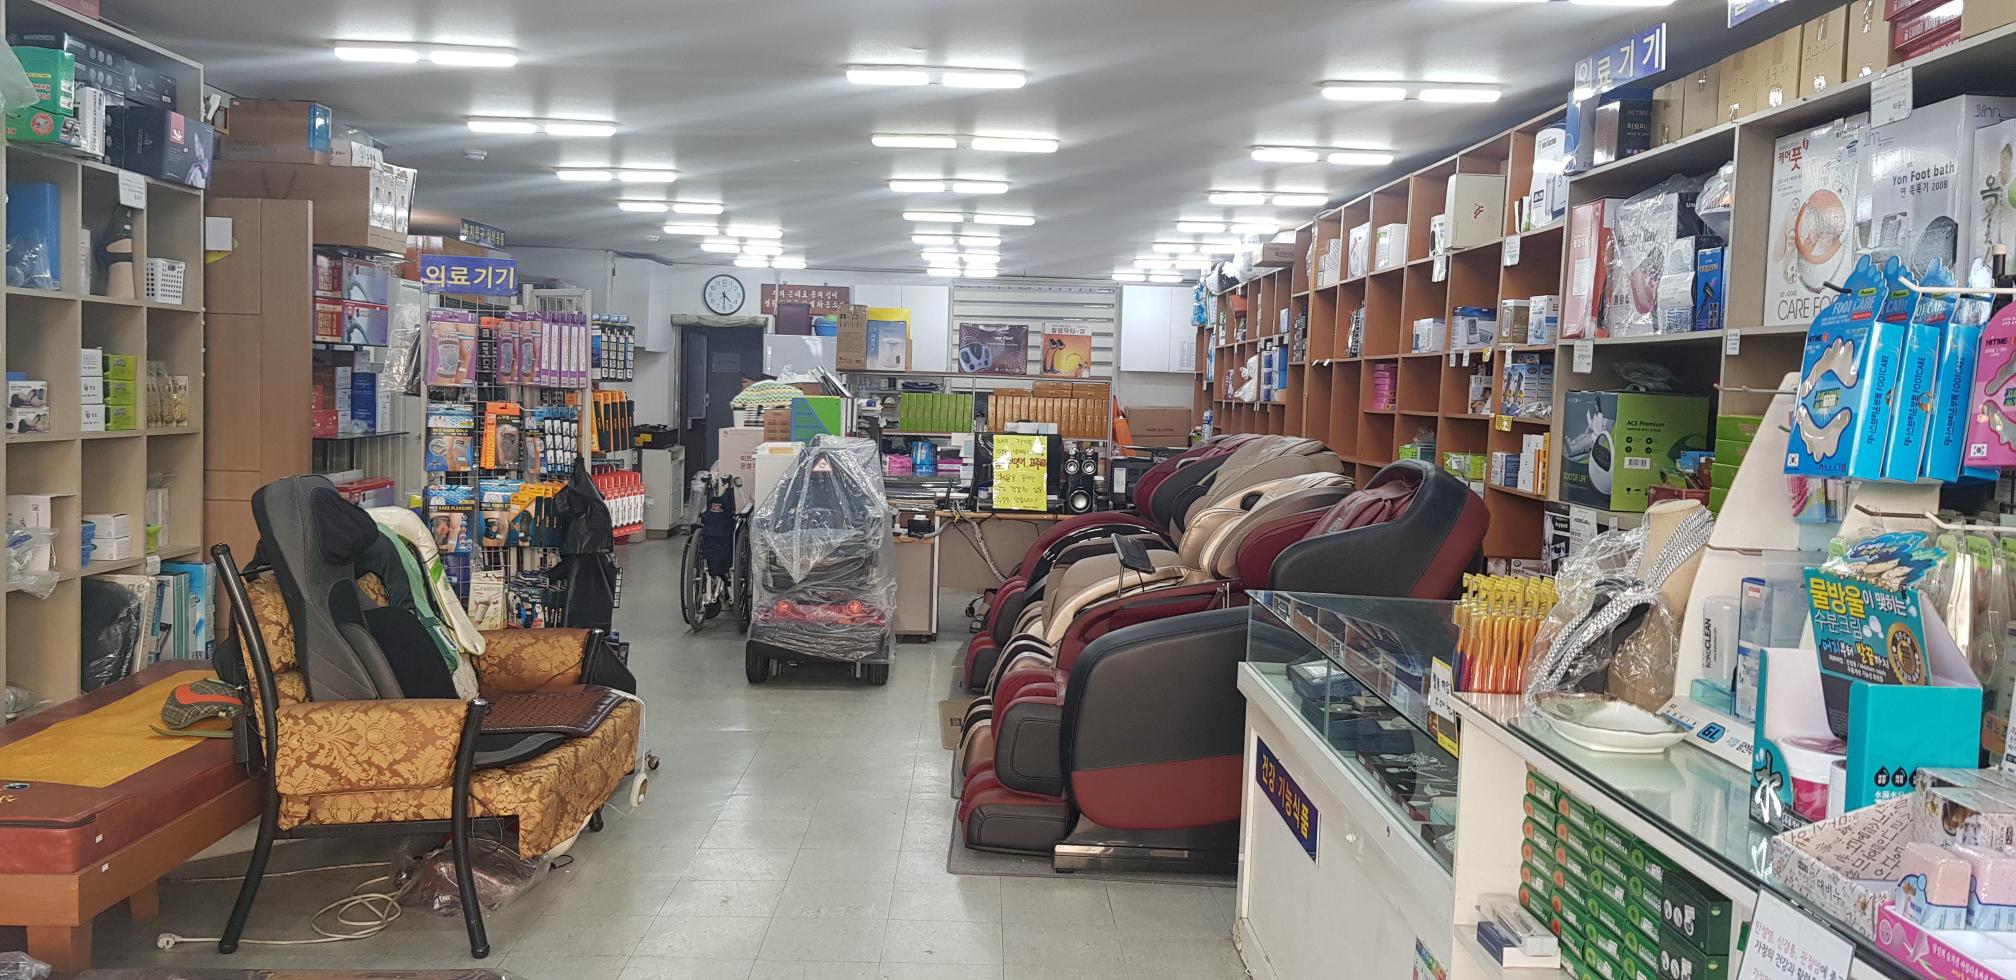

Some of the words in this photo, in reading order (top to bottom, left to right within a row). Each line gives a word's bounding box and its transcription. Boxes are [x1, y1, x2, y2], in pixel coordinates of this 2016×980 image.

[1577, 28, 1661, 88] 의료기기
[1892, 175, 1908, 187] Yon
[1910, 167, 1931, 182] Foot
[1934, 161, 1955, 177] bath
[425, 265, 515, 290] 의료기기
[1777, 298, 1809, 321] CARE
[1809, 577, 1875, 619] 물방울이
[1875, 592, 1908, 618] 맺히는
[1814, 610, 1864, 640] 수분크림
[1701, 725, 1720, 740] GL
[1261, 753, 1277, 796] 건강
[1277, 782, 1310, 841] 기능식품
[1754, 939, 1775, 962] 가정의
[1775, 952, 1796, 976] 건강과
